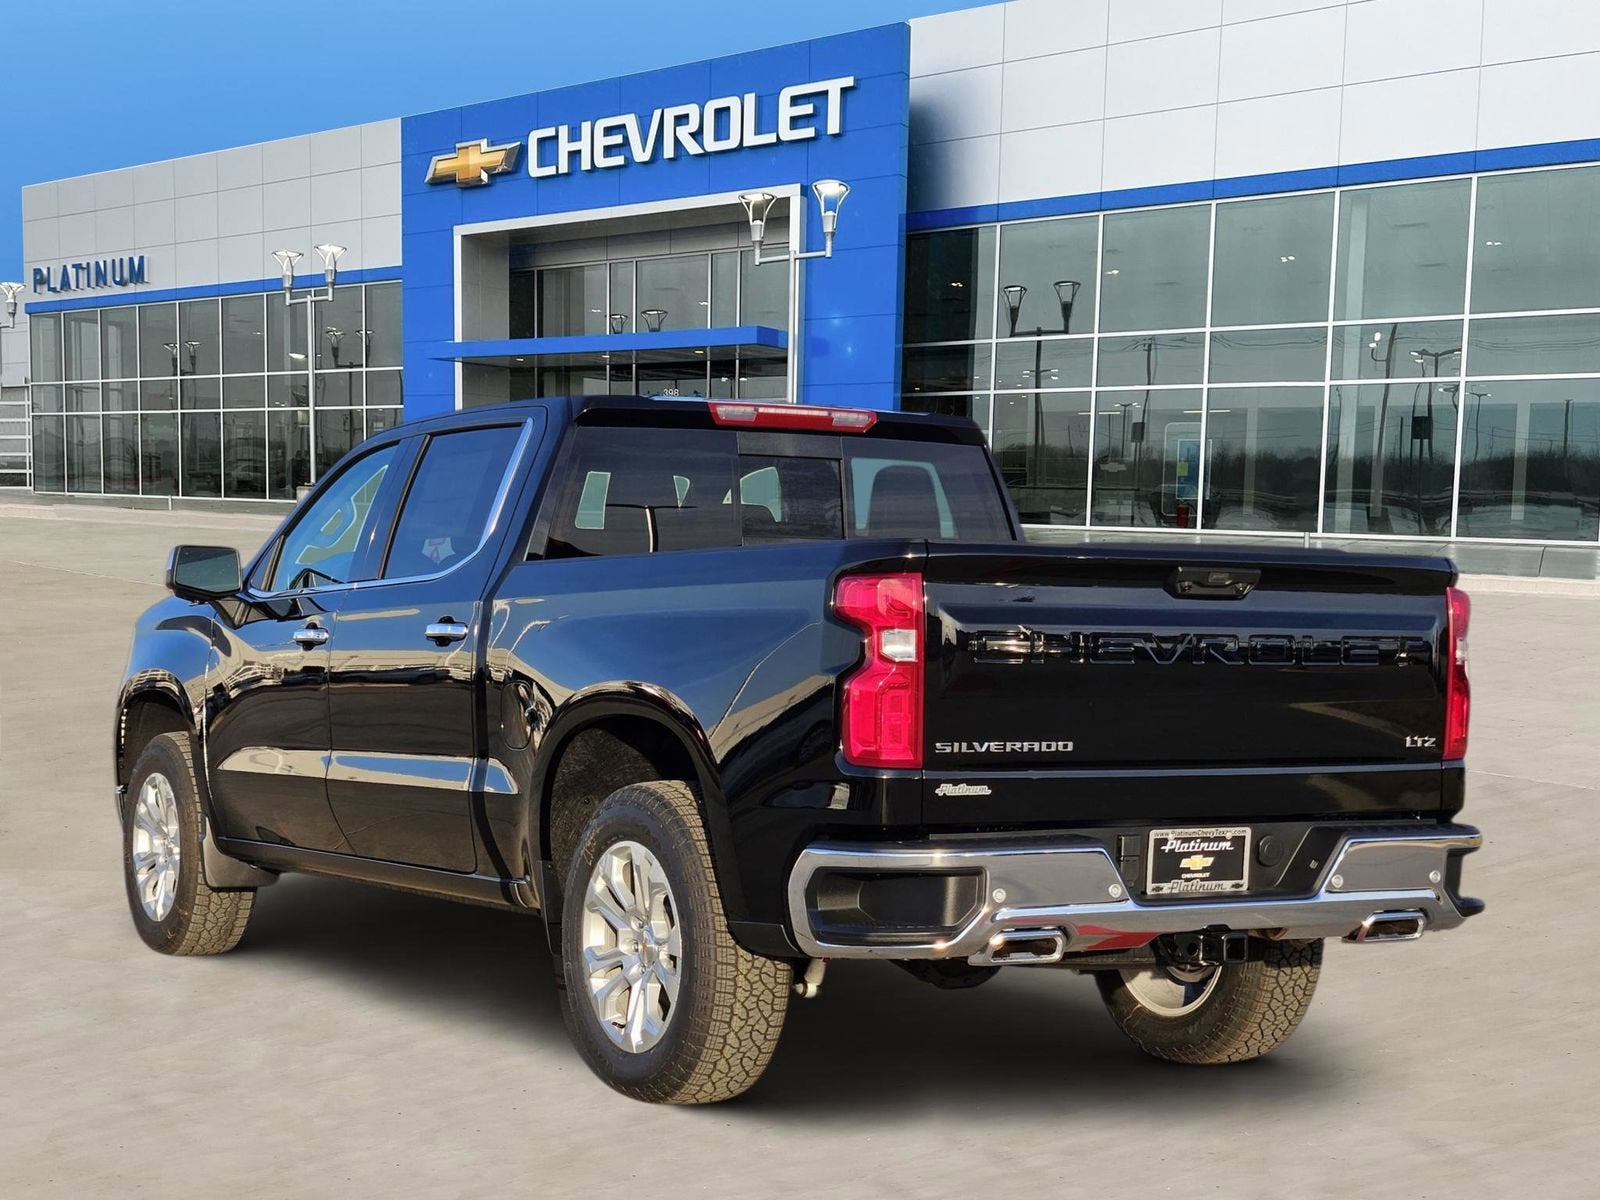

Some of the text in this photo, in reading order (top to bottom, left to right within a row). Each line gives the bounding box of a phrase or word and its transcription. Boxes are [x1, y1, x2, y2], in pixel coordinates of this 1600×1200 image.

[527, 75, 855, 178] CHEVROLET
[33, 255, 145, 294] PLATINUM
[663, 388, 679, 397] 398
[968, 631, 1423, 665] CHEVROLET
[935, 741, 1074, 753] SILVERADO
[1405, 735, 1436, 747] LTZ
[935, 783, 992, 796] Platinum
[1154, 829, 1247, 837] wwwPlatinumChevyTexa.com
[1160, 838, 1235, 853] Platinum
[1167, 880, 1228, 893] Platinum
